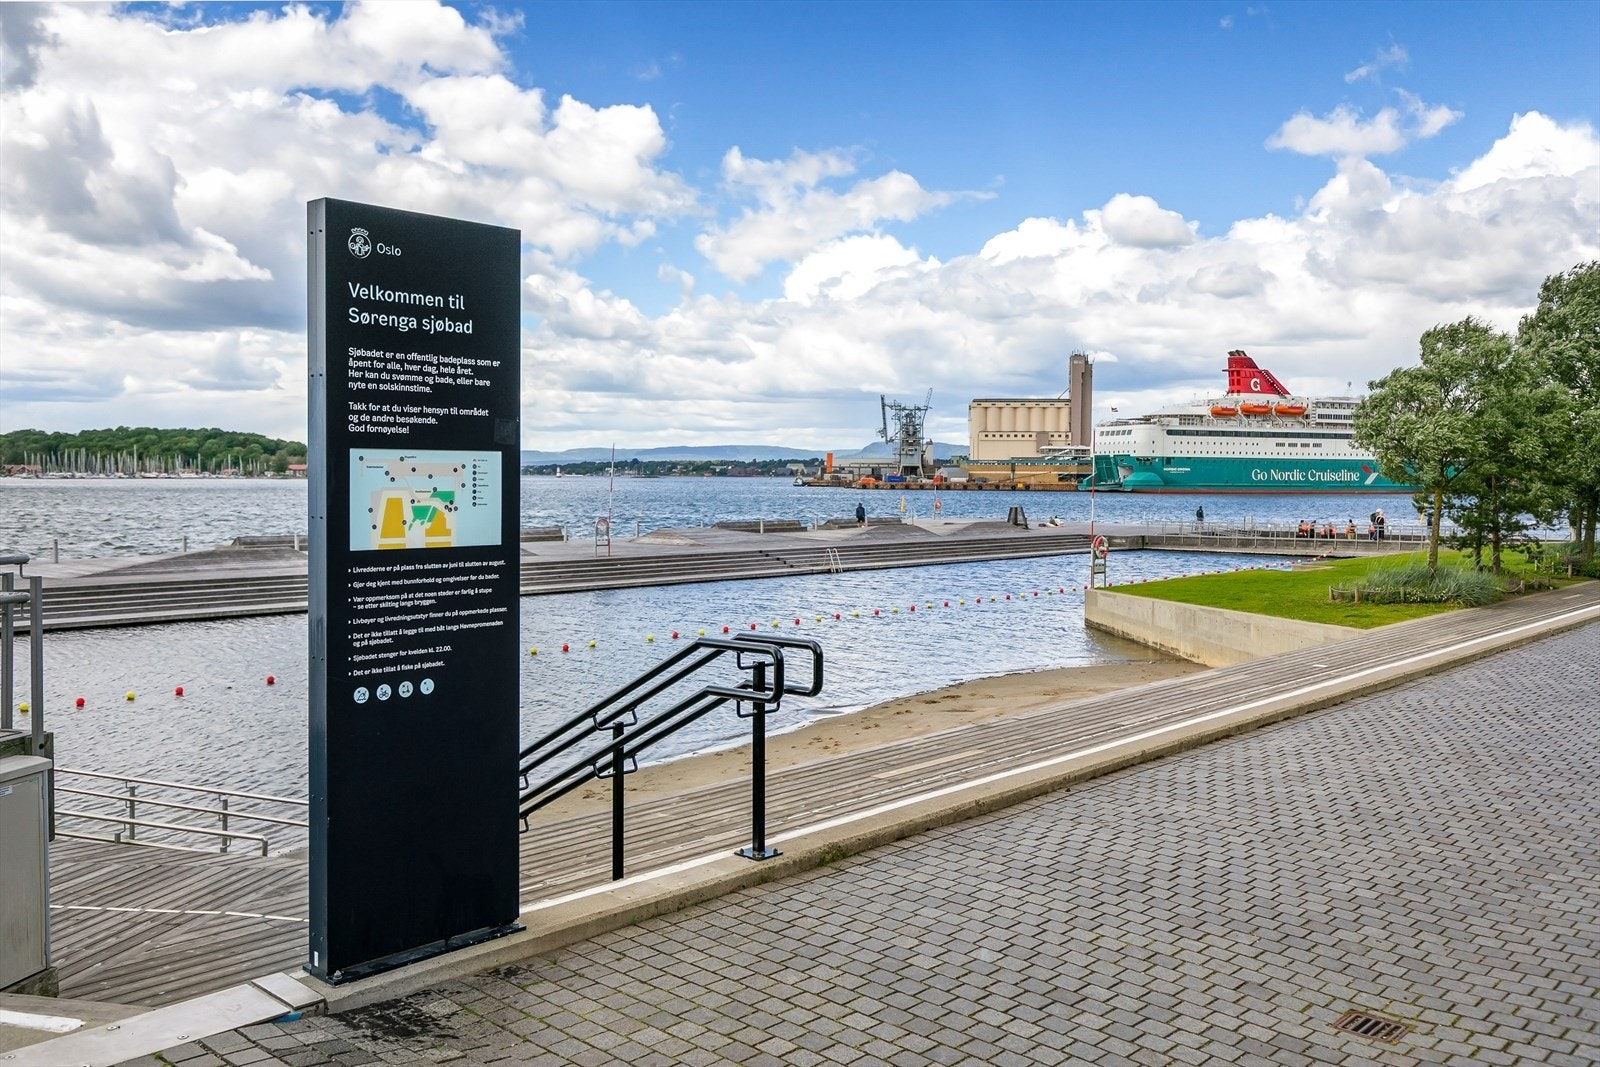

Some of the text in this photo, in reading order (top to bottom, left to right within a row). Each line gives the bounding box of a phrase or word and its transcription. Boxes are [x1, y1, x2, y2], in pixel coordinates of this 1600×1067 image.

[377, 243, 401, 256] Oslo
[348, 282, 465, 310] Velkommen til
[349, 307, 472, 334] Sørenga sjøbad
[349, 347, 384, 358] Sjøbadet
[406, 352, 438, 364] offentlig
[439, 355, 476, 366] badeplass
[348, 358, 474, 375] åpent for alle, hver dag, hele året.
[349, 369, 490, 386] Her kan du svømme og bade, eller bare
[349, 381, 366, 390] nyte
[379, 383, 433, 393] solskinnstime.
[1250, 378, 1261, 392] G
[348, 402, 367, 410] Takk
[369, 403, 381, 411] for
[403, 405, 422, 413] viser
[423, 406, 449, 417] hensyn
[459, 408, 489, 416] området
[348, 413, 438, 424] og de andre besøkende.
[348, 422, 409, 435] God fornøyelse!
[1252, 469, 1360, 481] Go Nordic Cruiseline
